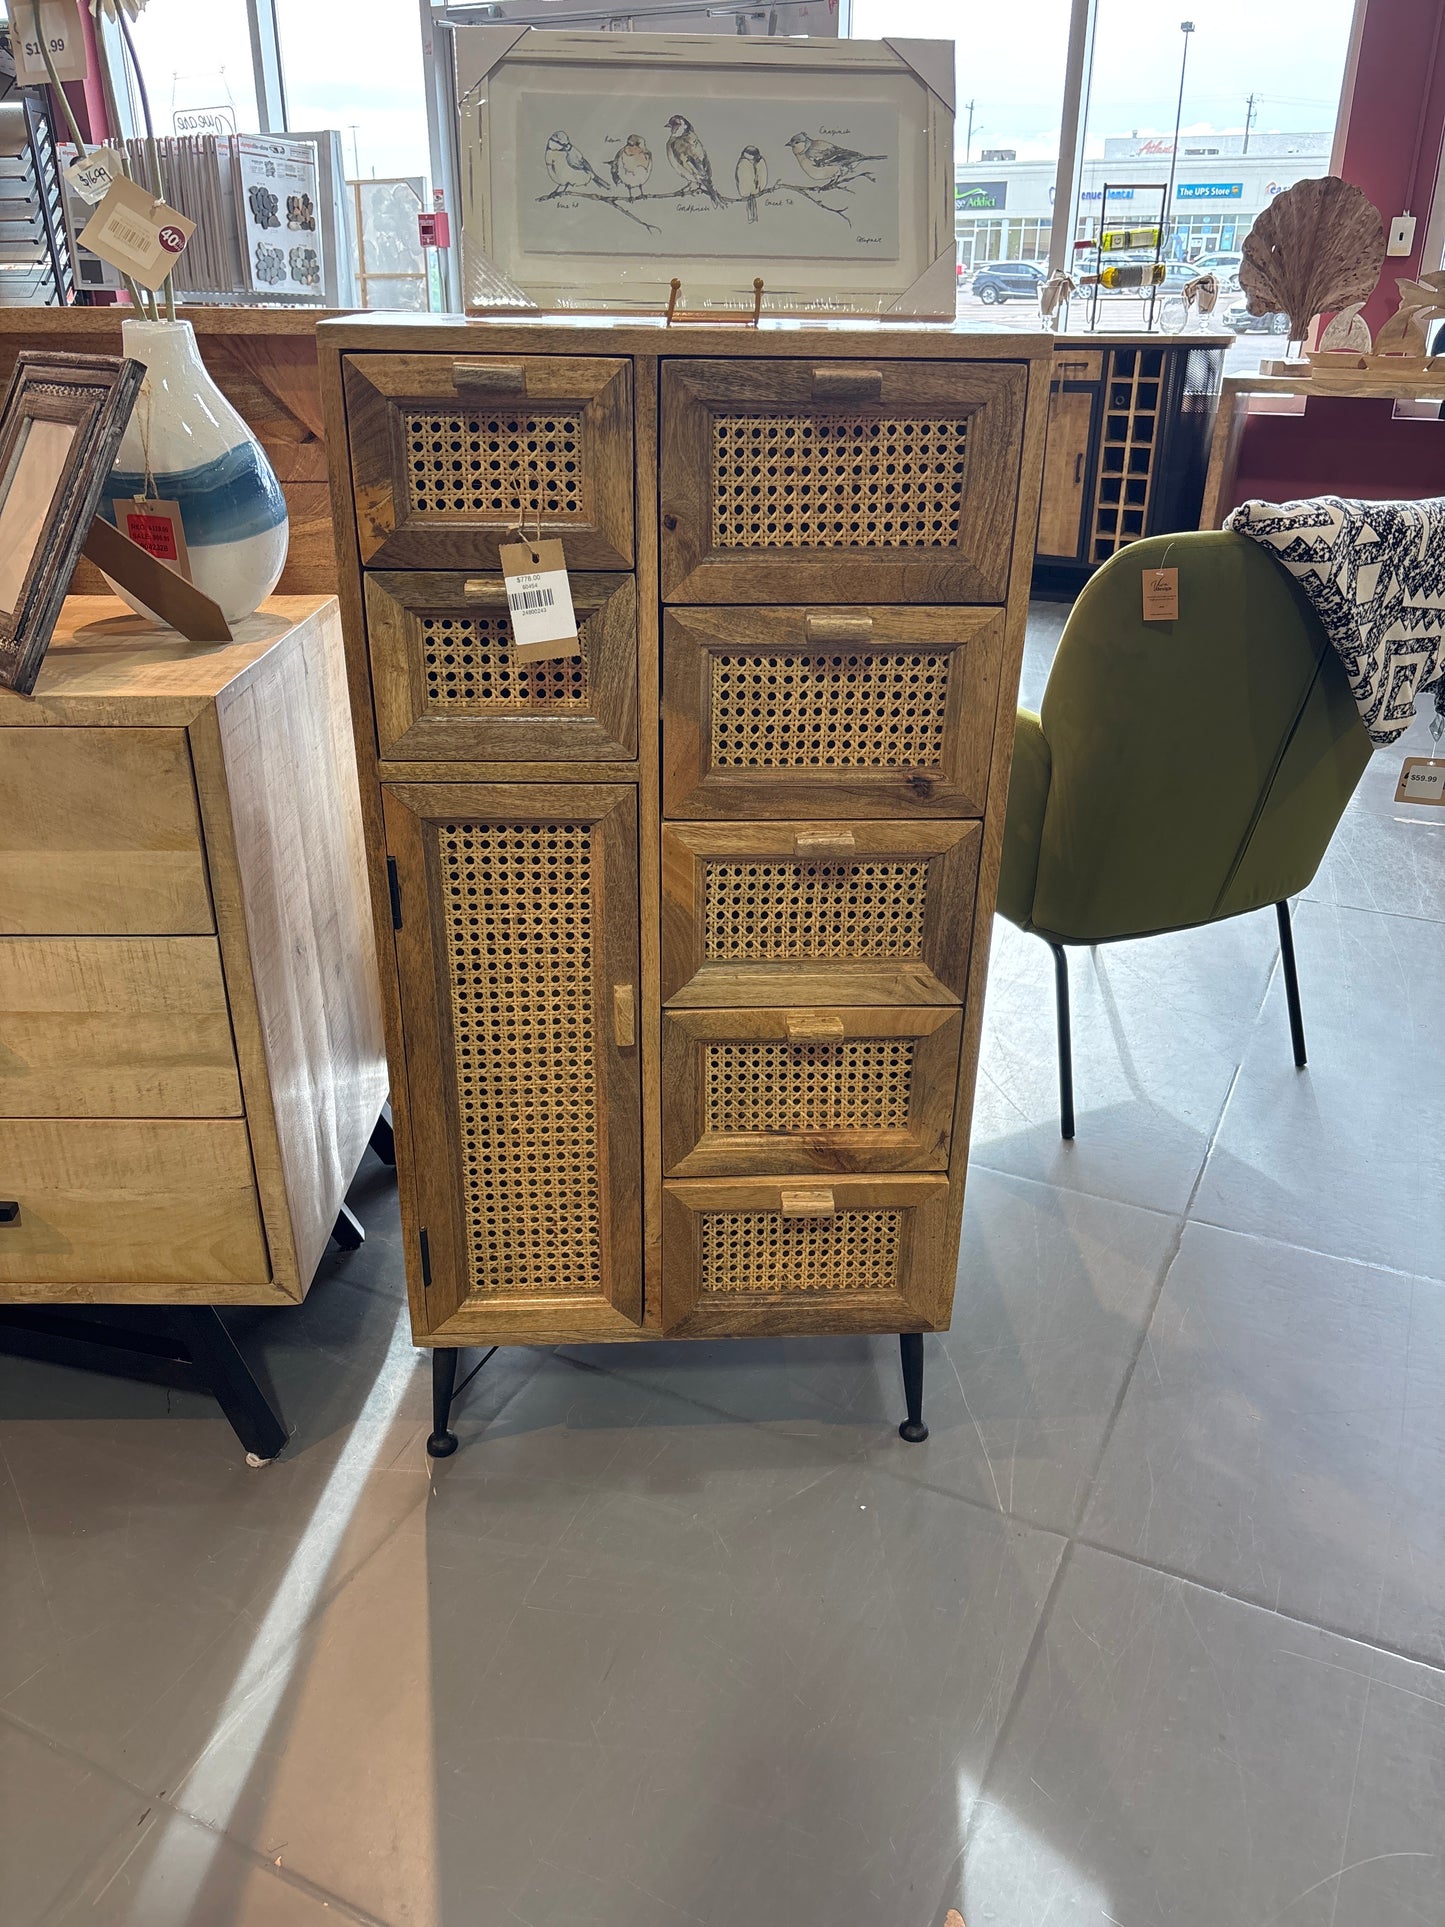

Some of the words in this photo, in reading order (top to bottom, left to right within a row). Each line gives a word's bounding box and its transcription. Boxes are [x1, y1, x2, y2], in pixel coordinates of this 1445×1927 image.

[25, 38, 65, 56] $1.99
[1180, 188, 1193, 196] The
[1194, 188, 1210, 196] UPS
[517, 575, 541, 583] $778.00
[1410, 774, 1438, 783] $59.99
